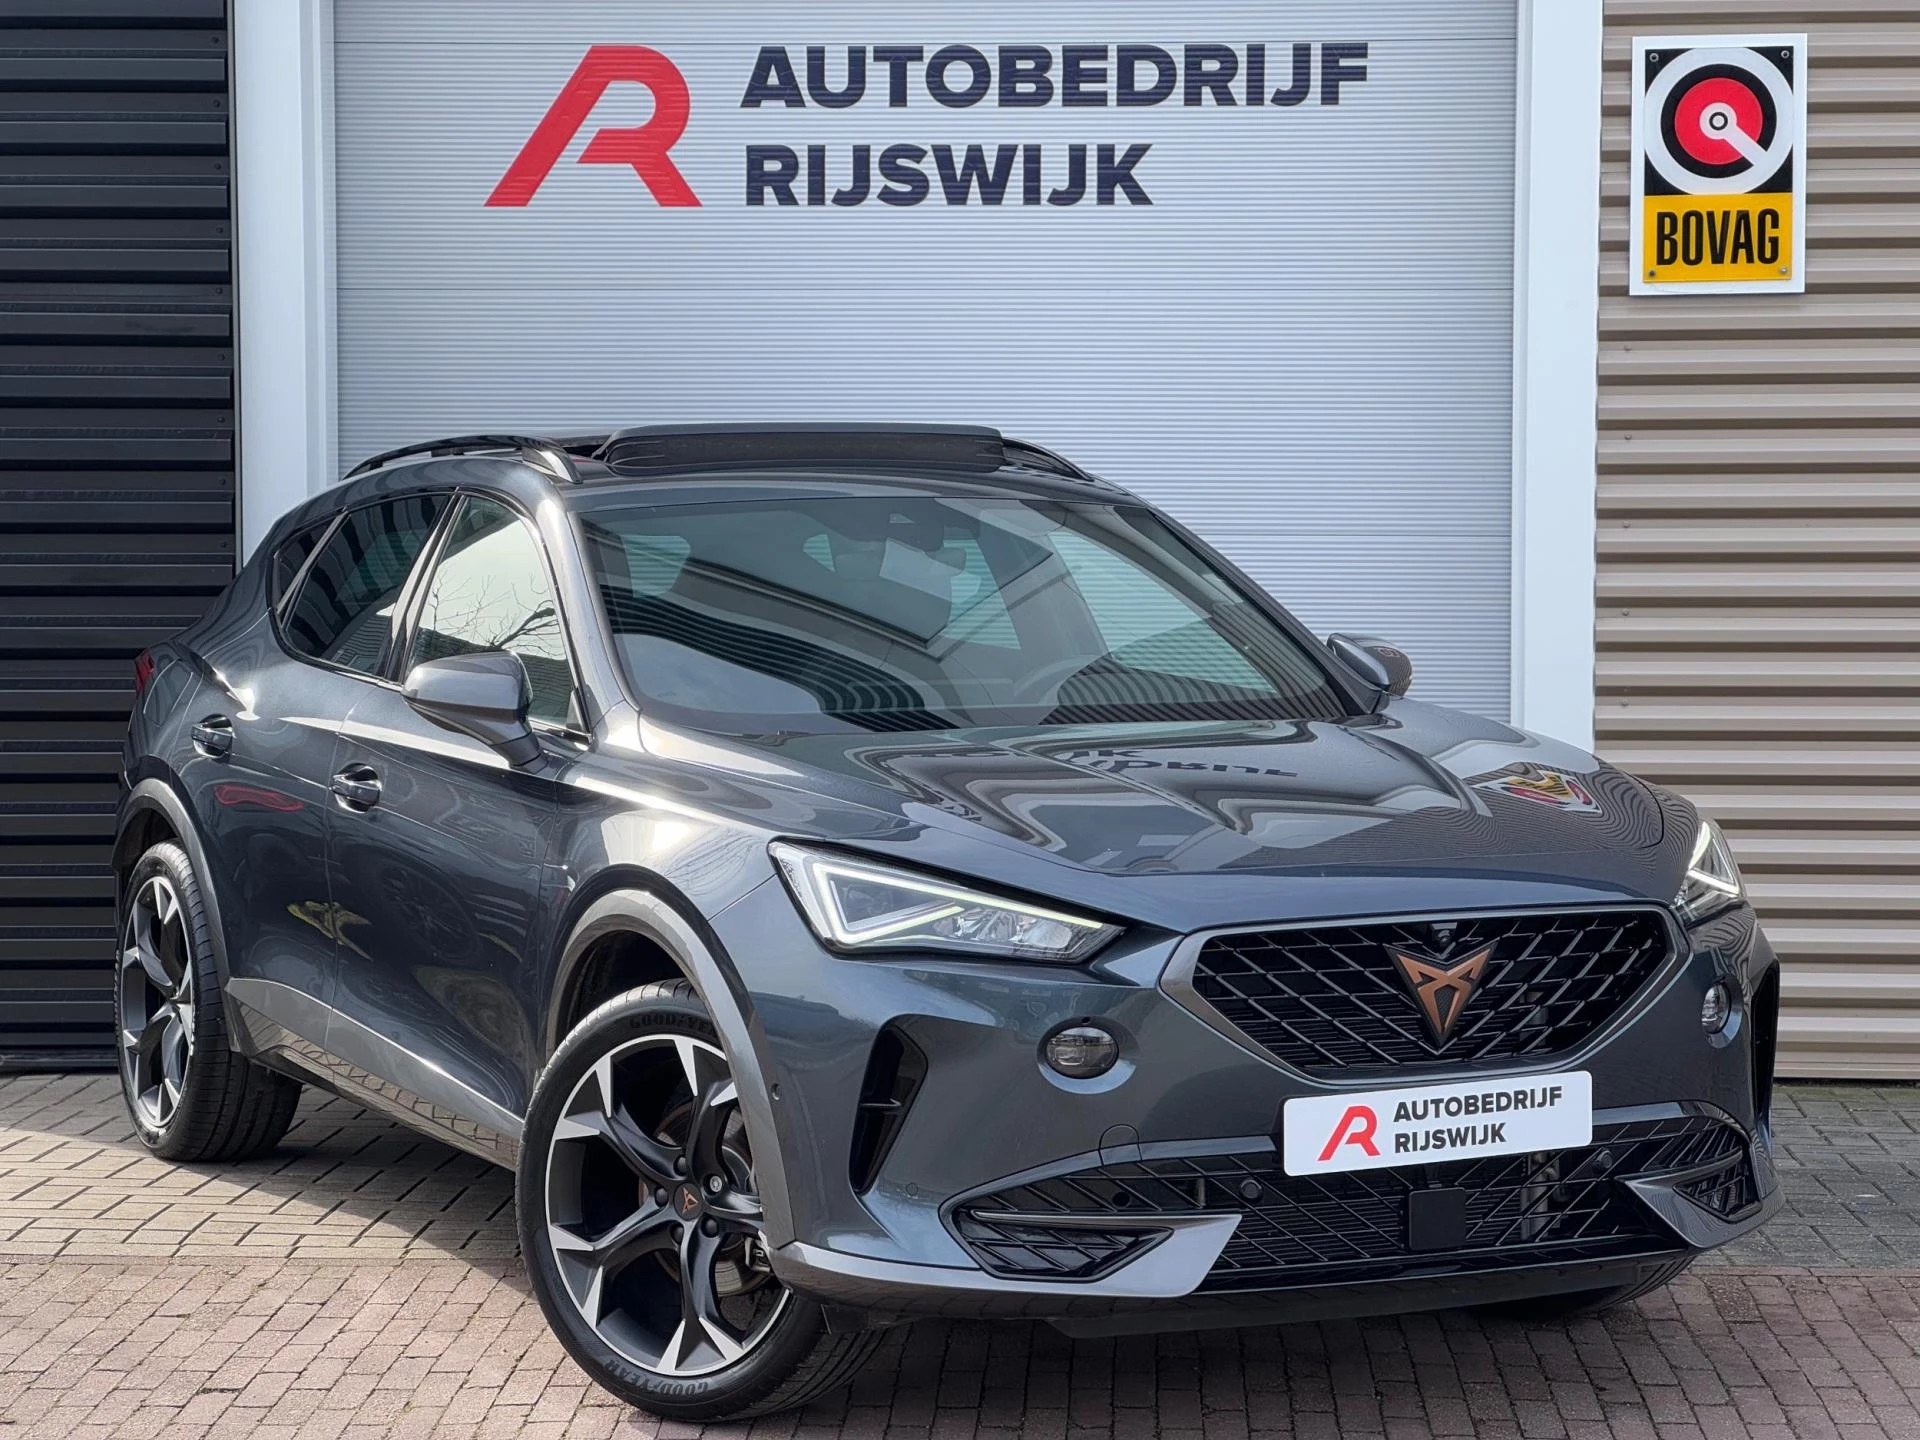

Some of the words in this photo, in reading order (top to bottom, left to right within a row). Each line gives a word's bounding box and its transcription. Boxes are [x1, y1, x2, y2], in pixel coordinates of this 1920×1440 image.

[740, 43, 1369, 109] AUTOBEDRIJF
[746, 143, 1154, 207] RIJSWIJK
[1656, 208, 1780, 266] BOVAG
[1393, 1085, 1563, 1123] AUTOBEDRIJF
[1394, 1122, 1506, 1153] RIJSWIJK
